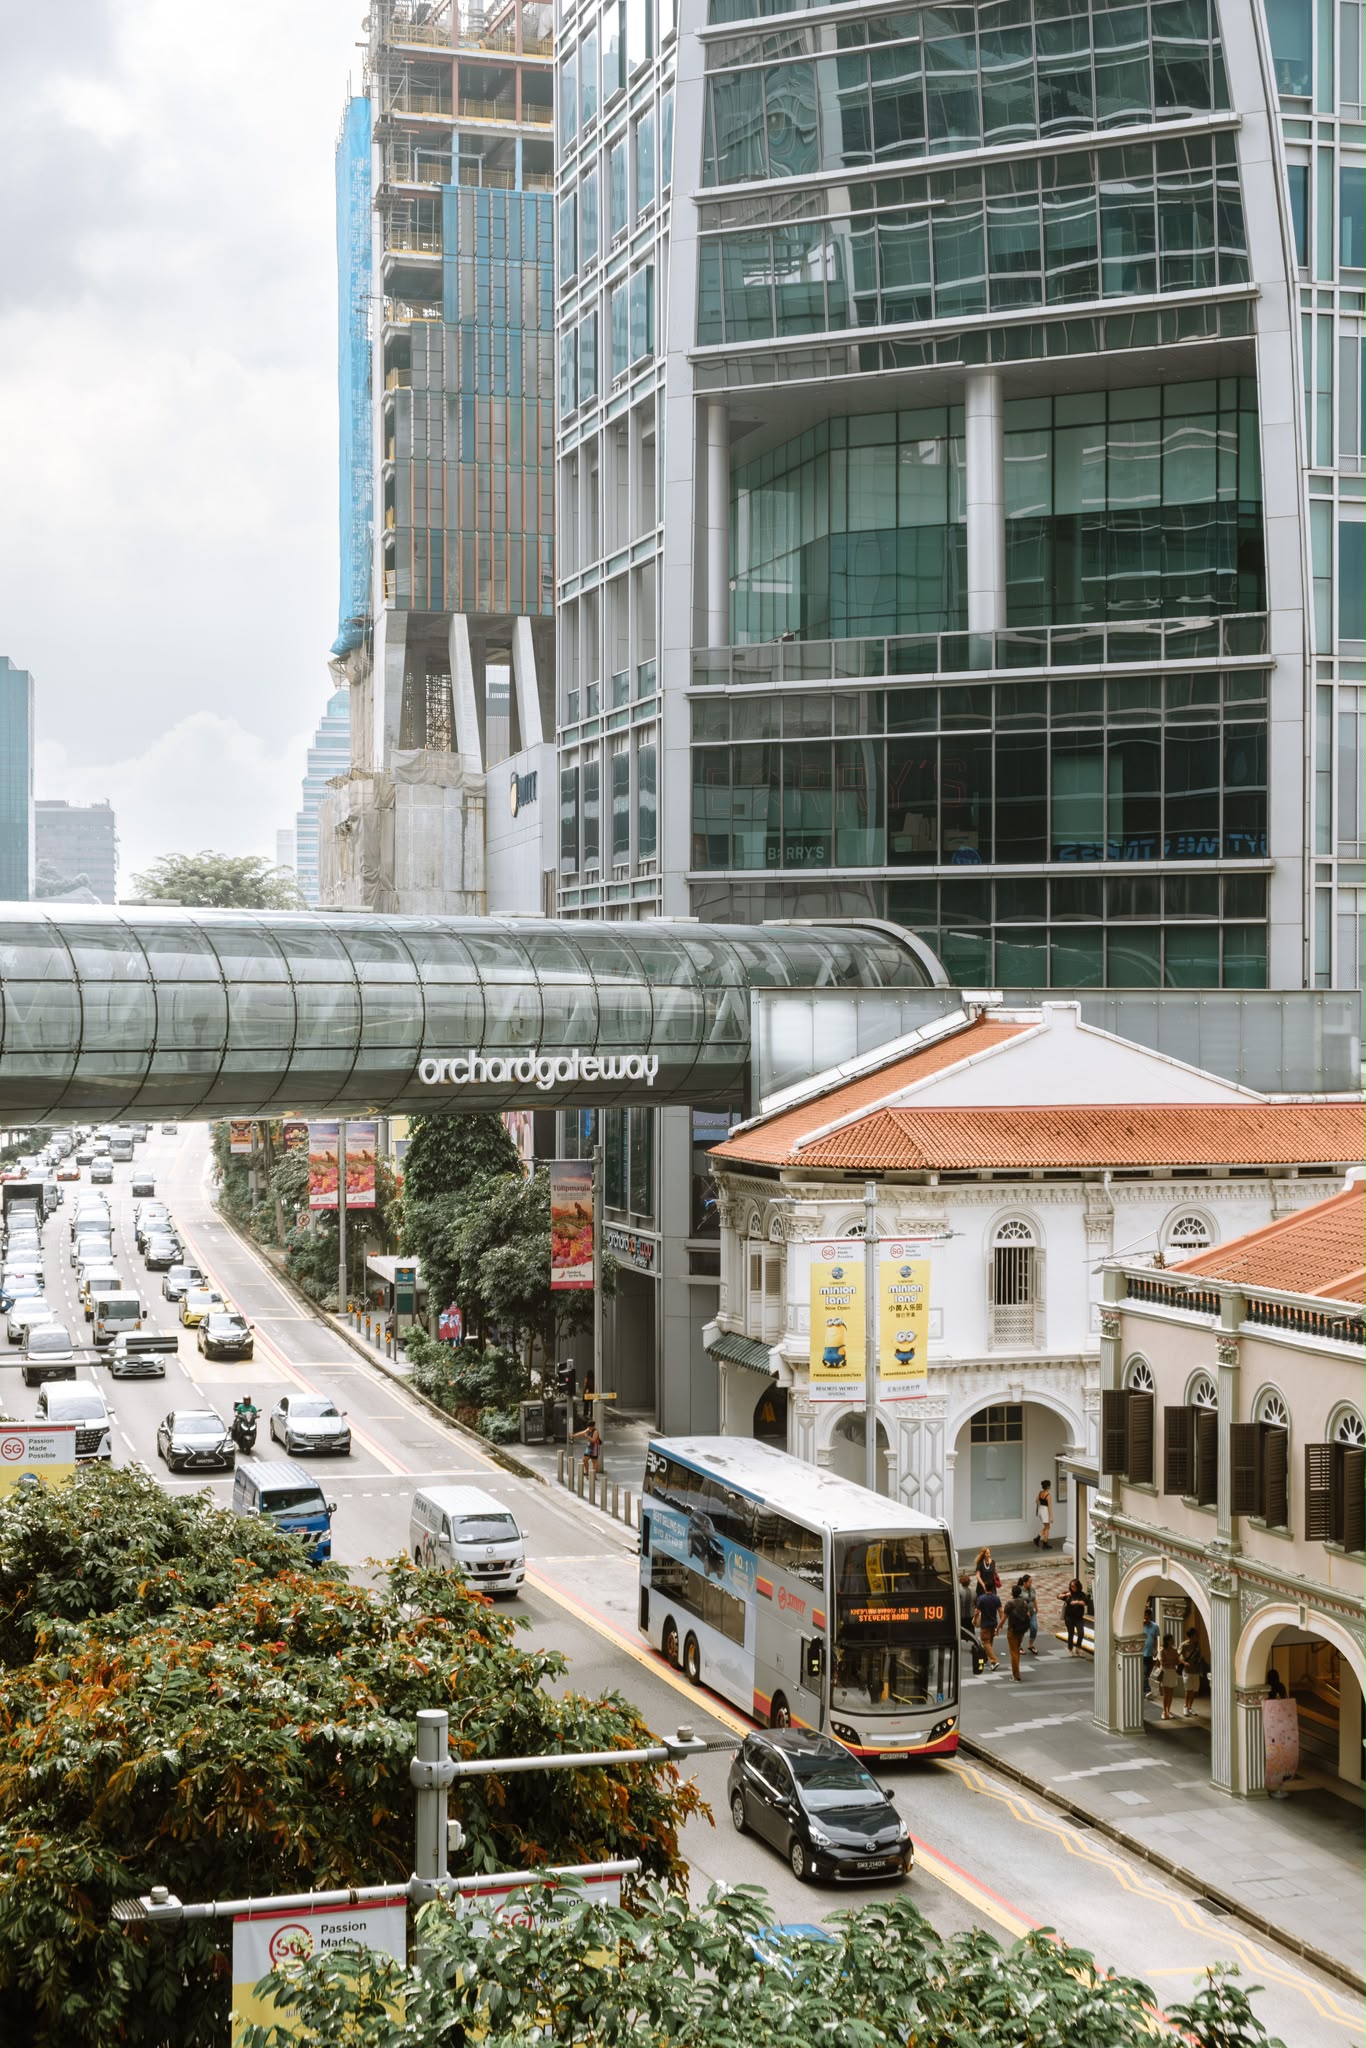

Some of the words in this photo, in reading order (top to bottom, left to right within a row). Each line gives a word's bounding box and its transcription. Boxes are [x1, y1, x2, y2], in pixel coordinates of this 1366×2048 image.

[418, 1048, 659, 1090] orchardgateway
[820, 1286, 856, 1295] minion
[888, 1284, 923, 1293] minion
[826, 1296, 850, 1305] land
[894, 1294, 918, 1303] land
[647, 1453, 668, 1473] BYD
[923, 1605, 944, 1619] 190
[858, 1614, 891, 1622] STEVENS
[320, 1921, 367, 1935] Passion
